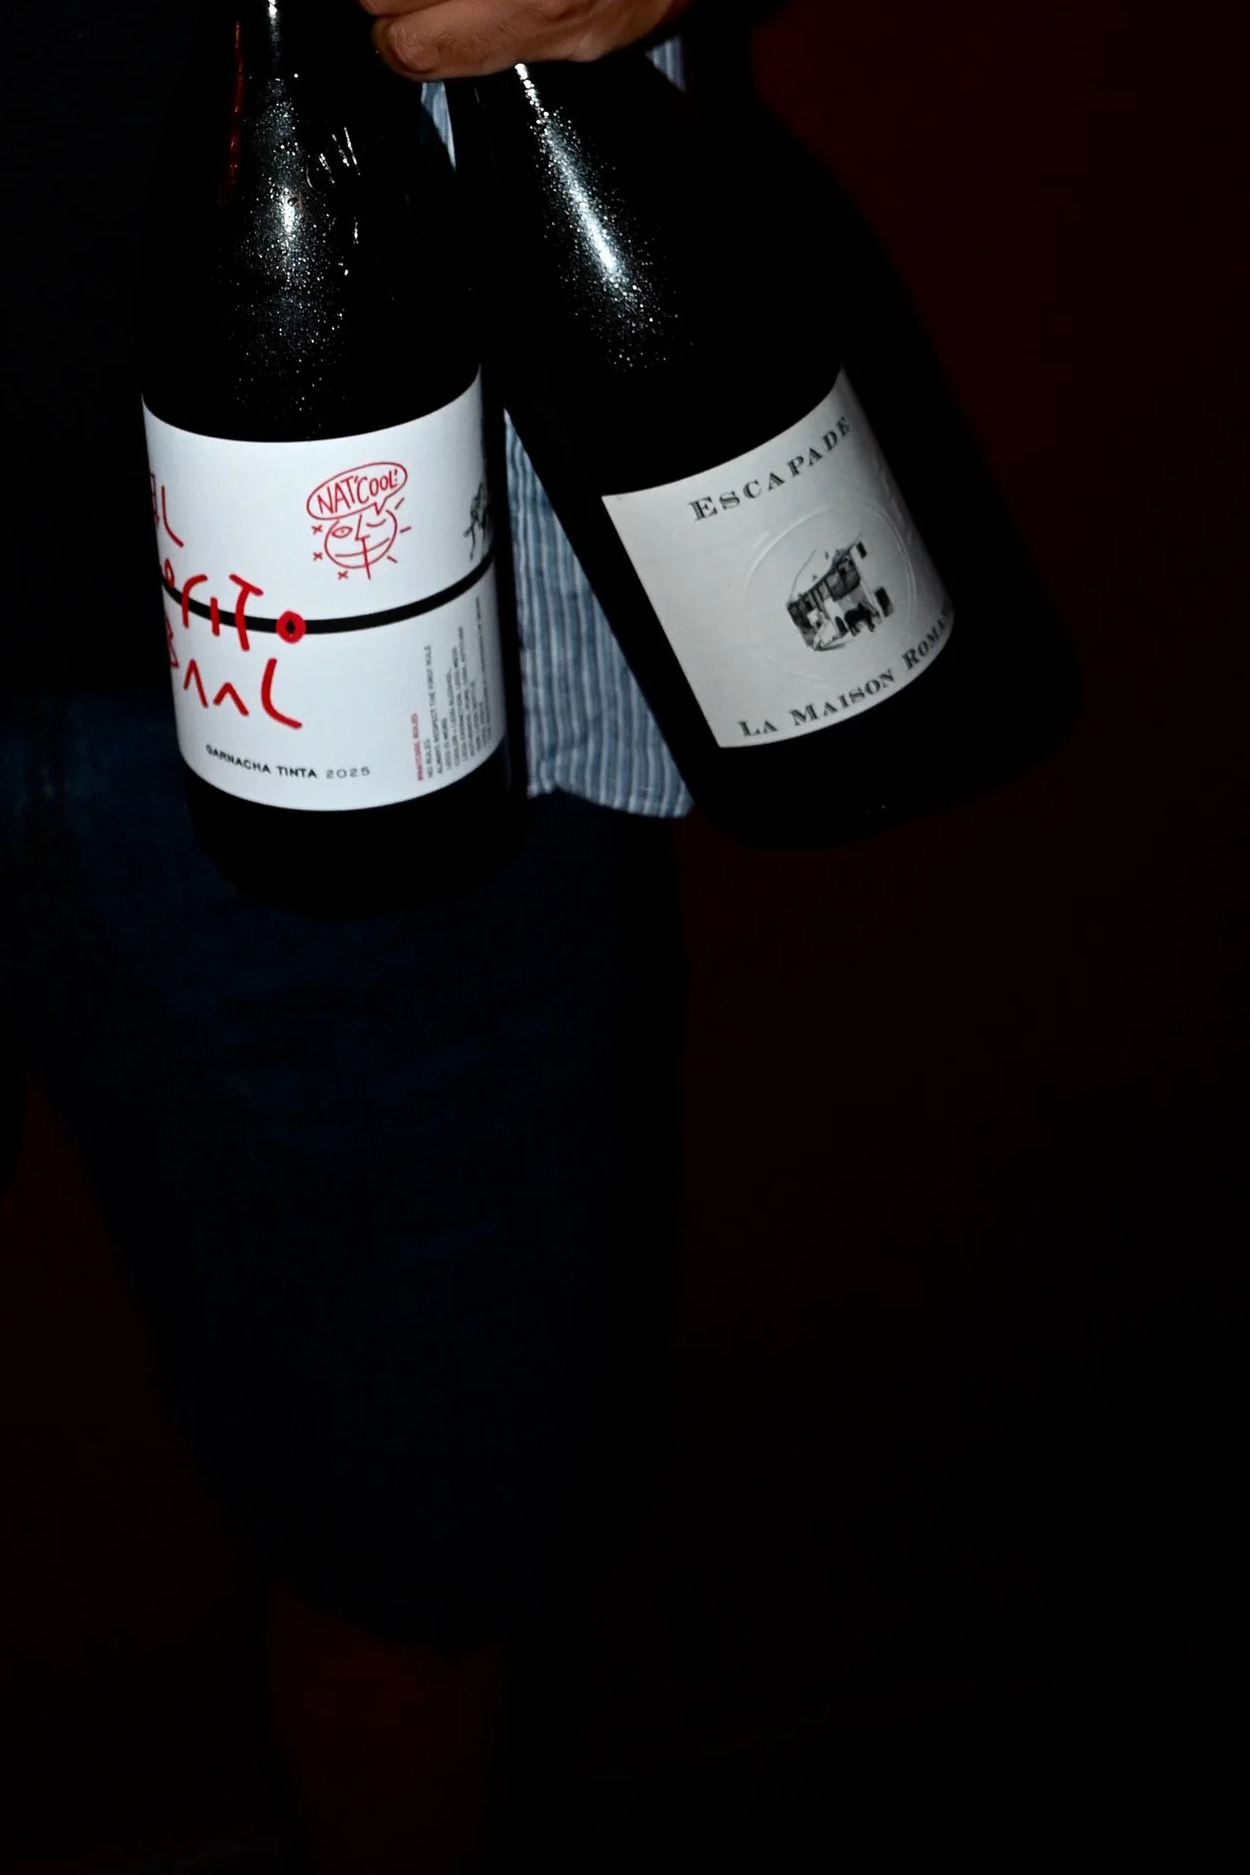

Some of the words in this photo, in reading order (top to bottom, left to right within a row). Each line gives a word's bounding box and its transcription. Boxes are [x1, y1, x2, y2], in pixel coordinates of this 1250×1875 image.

[688, 416, 850, 521] ESCAPADE
[738, 719, 779, 738] LA
[789, 669, 895, 727] MAISON
[205, 744, 271, 774] GARNACHA
[276, 765, 318, 779] TINTA
[325, 766, 371, 779] 2025
